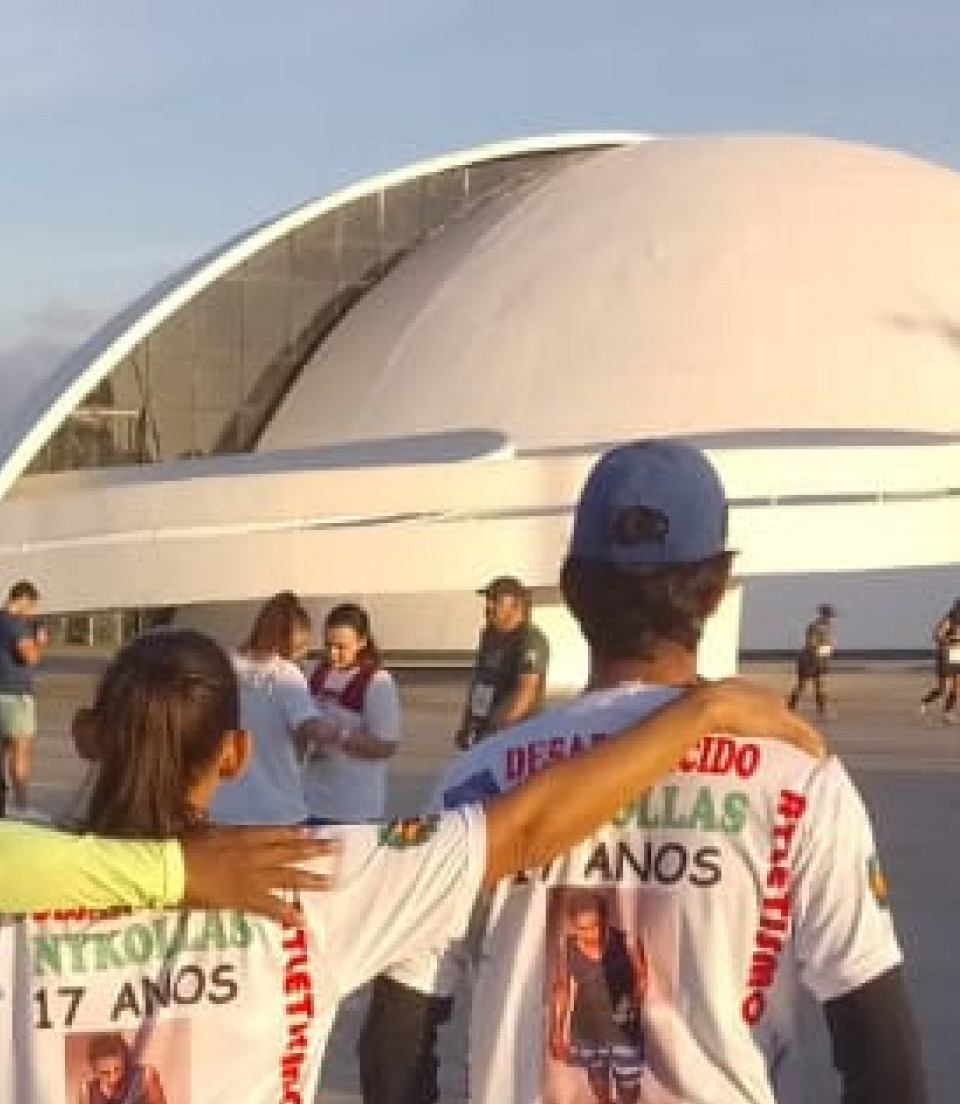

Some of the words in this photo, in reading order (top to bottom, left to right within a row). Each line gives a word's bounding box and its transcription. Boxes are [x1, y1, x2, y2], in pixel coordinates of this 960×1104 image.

[583, 842, 723, 888] ANOS
[33, 985, 87, 1029] 17
[110, 965, 238, 1022] ANOS
